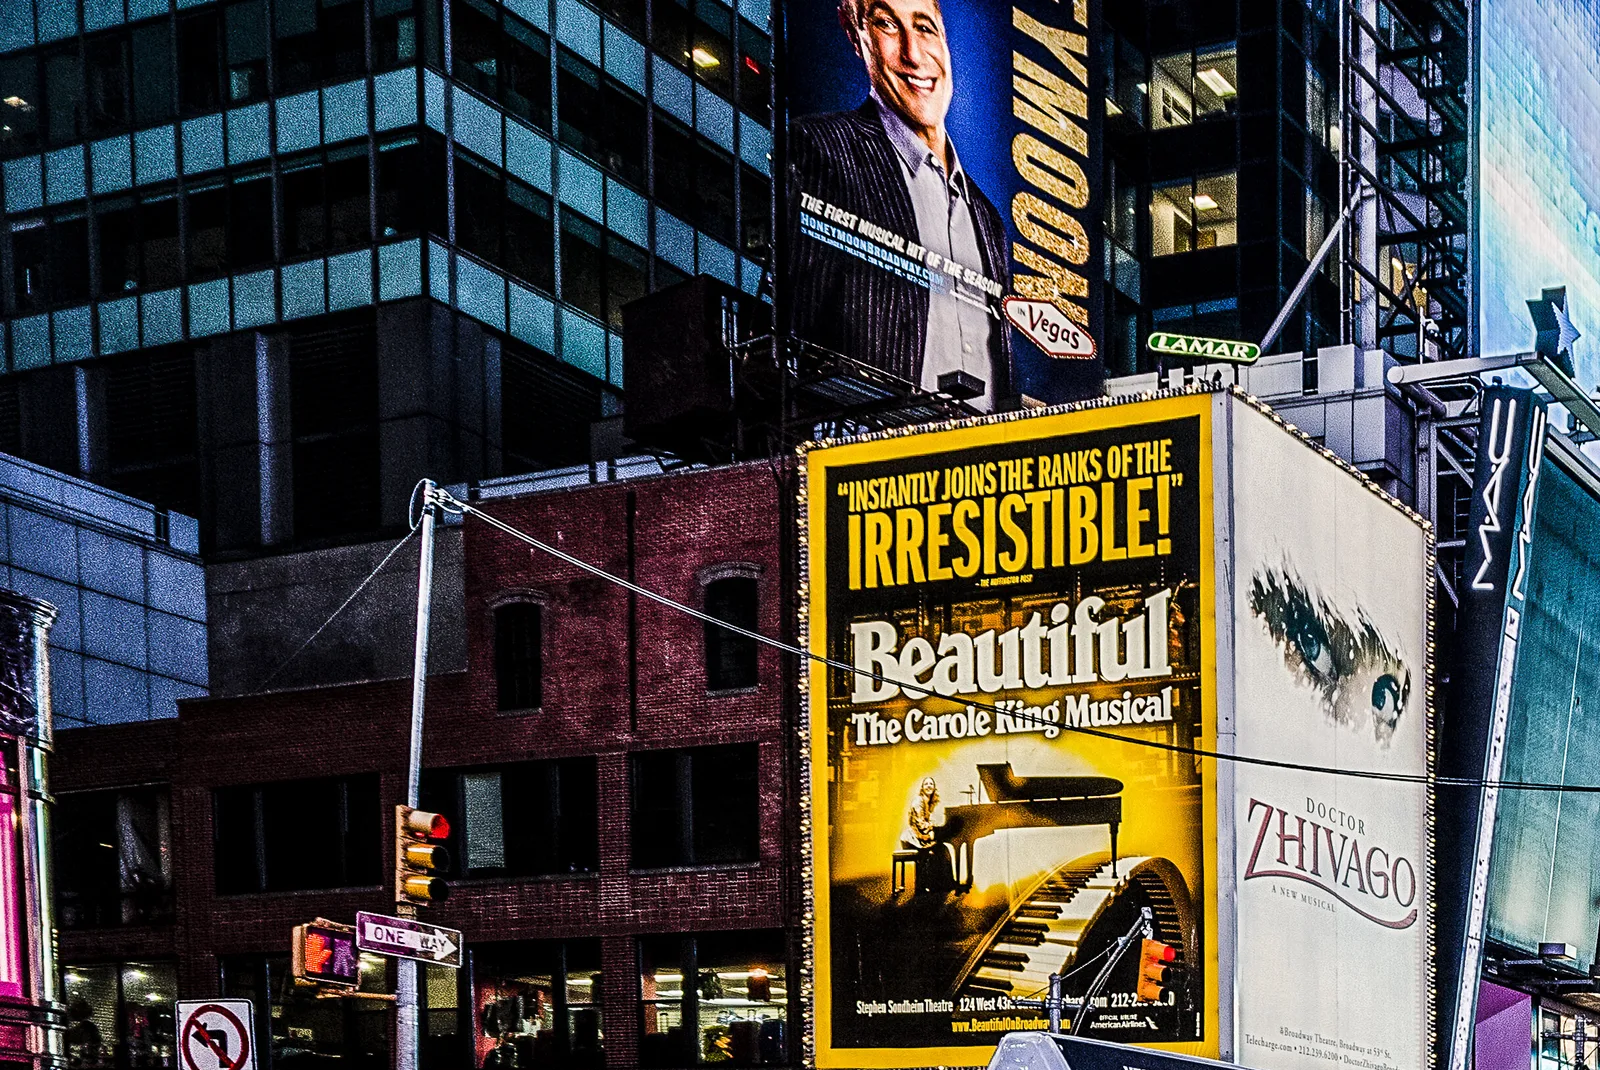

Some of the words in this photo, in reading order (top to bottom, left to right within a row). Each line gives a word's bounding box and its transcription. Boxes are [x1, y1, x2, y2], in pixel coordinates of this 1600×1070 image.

[801, 192, 824, 215] THE
[824, 205, 860, 231] FIRST
[859, 219, 906, 253] MUSICAL
[907, 240, 927, 262] HIT
[927, 249, 943, 267] OF
[943, 257, 963, 279] THE
[801, 212, 944, 287] HONEYMOONBROADWAY.COM
[1018, 306, 1026, 317] IN
[1028, 304, 1080, 350] Vegas
[1157, 335, 1251, 358] LAMAR
[941, 460, 999, 501] JOINS
[997, 456, 1033, 493] THE
[1038, 448, 1102, 488] RANKS
[1107, 444, 1137, 480] OF
[1135, 439, 1173, 474] THE
[850, 587, 1173, 705] Beautiful
[851, 711, 902, 747] The
[904, 706, 991, 742] Carole
[994, 695, 1061, 738] King
[1065, 686, 1173, 728] Musical
[1306, 797, 1366, 836] DOCTOR
[1244, 798, 1417, 908] ZHIVAGO
[1280, 887, 1298, 900] NEW
[1301, 893, 1336, 913] MUSICAL
[374, 926, 406, 944] ONE
[419, 935, 448, 952] WAY
[856, 1000, 887, 1017] Stephen
[887, 999, 925, 1015] Sondheim
[924, 998, 954, 1014] Theatre
[959, 998, 976, 1013] 124
[976, 996, 996, 1012] West
[1090, 1020, 1120, 1029] American
[1119, 1019, 1147, 1028] Airlines
[1245, 1034, 1293, 1054] Telecharge.com
[1298, 1045, 1339, 1062] 212.239.6200
[1284, 1027, 1314, 1047] Broadway
[1314, 1033, 1339, 1050] Theatre,
[1339, 1038, 1367, 1056] Broadway
[1366, 1046, 1373, 1054] at
